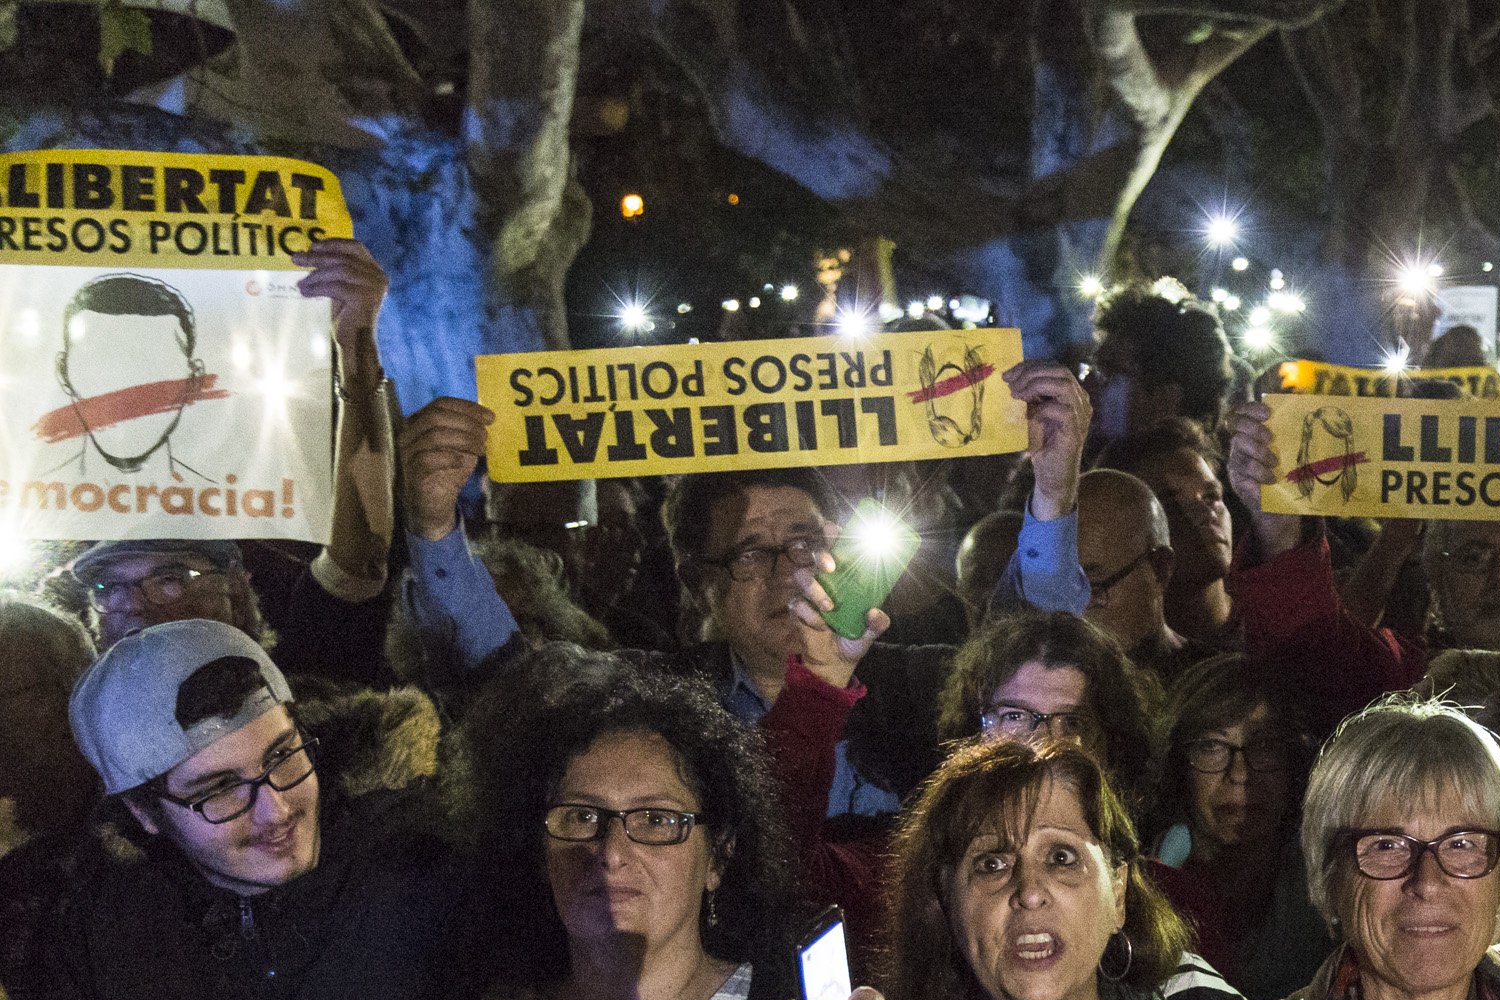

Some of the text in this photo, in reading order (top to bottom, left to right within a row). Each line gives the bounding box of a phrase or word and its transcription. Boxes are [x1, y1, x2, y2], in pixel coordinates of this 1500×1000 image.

[0, 163, 324, 220] LIBERTAT
[0, 215, 133, 254] RESOS
[722, 349, 893, 395] PRESOS
[518, 395, 899, 467] LLIBERTAT
[0, 473, 296, 519] mocràcia!
